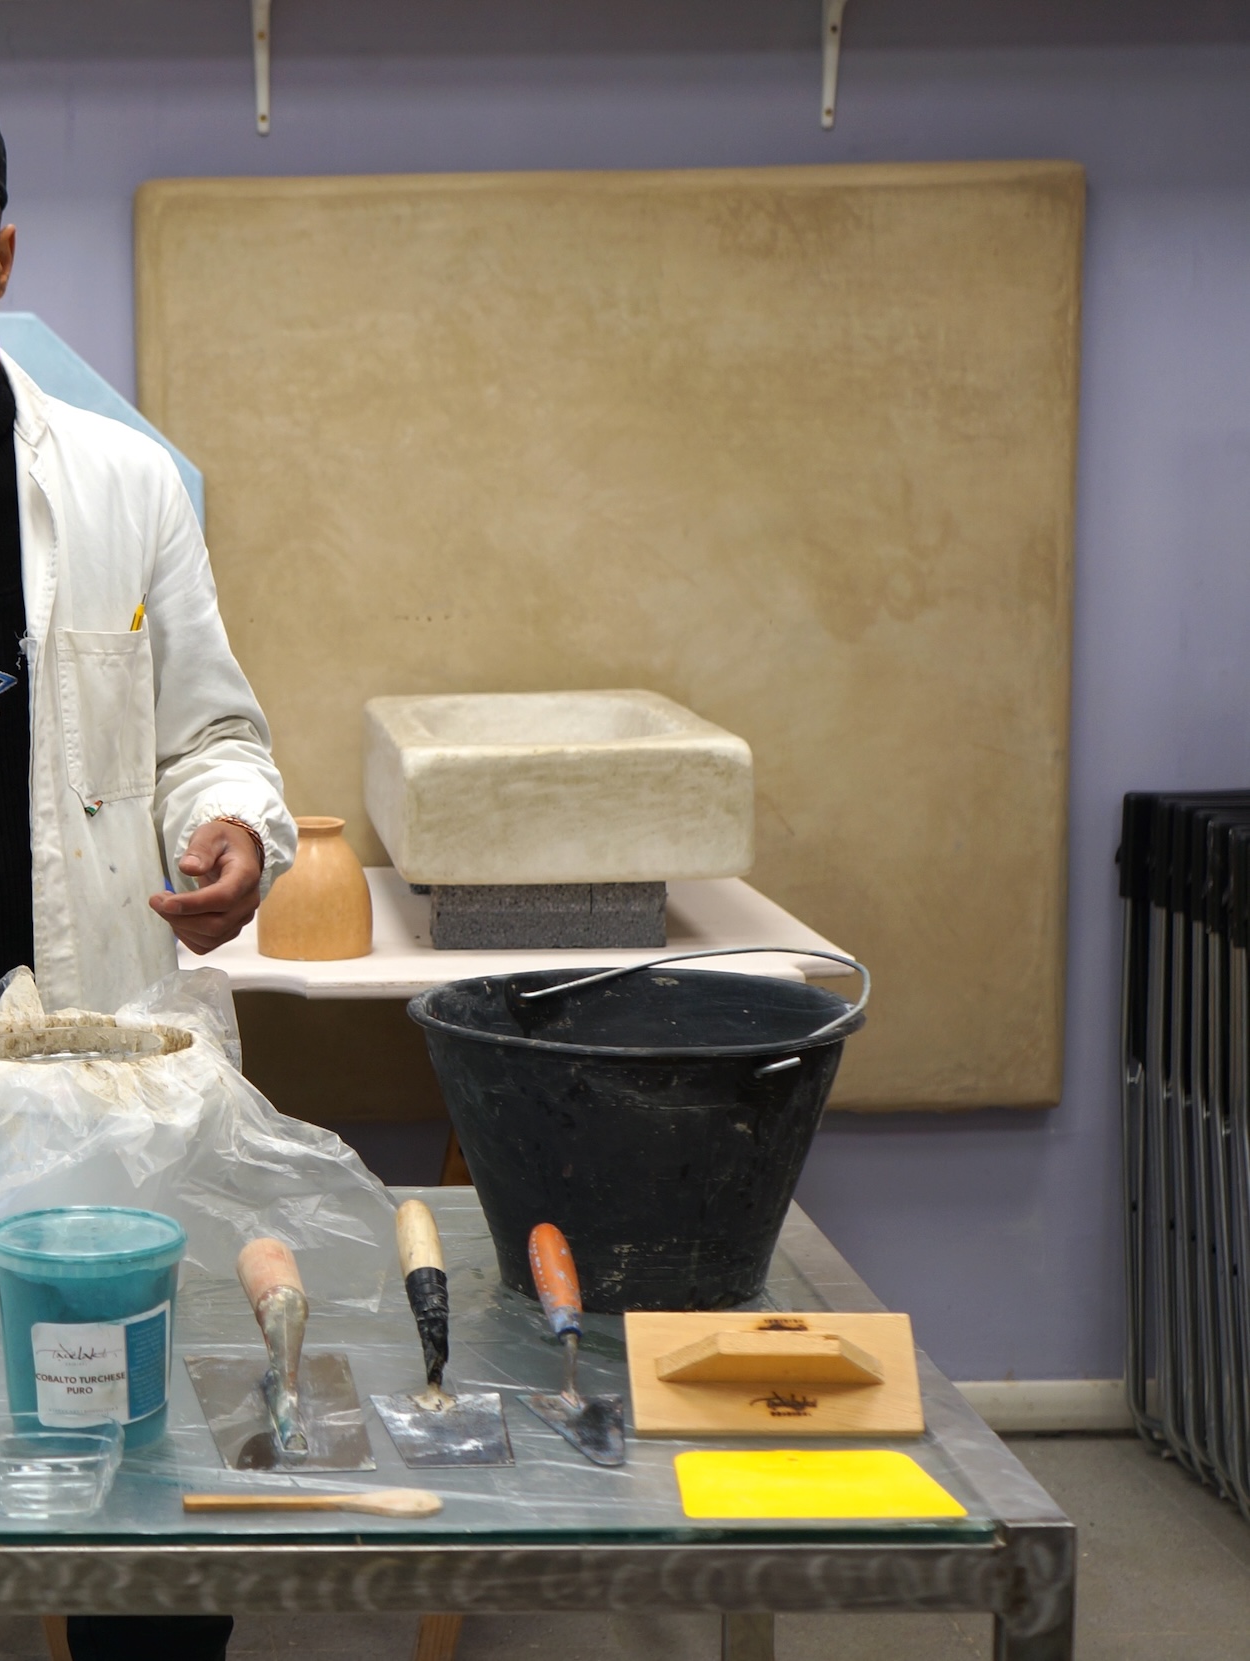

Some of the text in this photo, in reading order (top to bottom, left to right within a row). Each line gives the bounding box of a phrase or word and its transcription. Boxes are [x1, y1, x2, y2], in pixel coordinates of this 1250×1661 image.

[35, 1372, 126, 1384] COBALTO TURCHESE
[66, 1386, 93, 1395] PURO
